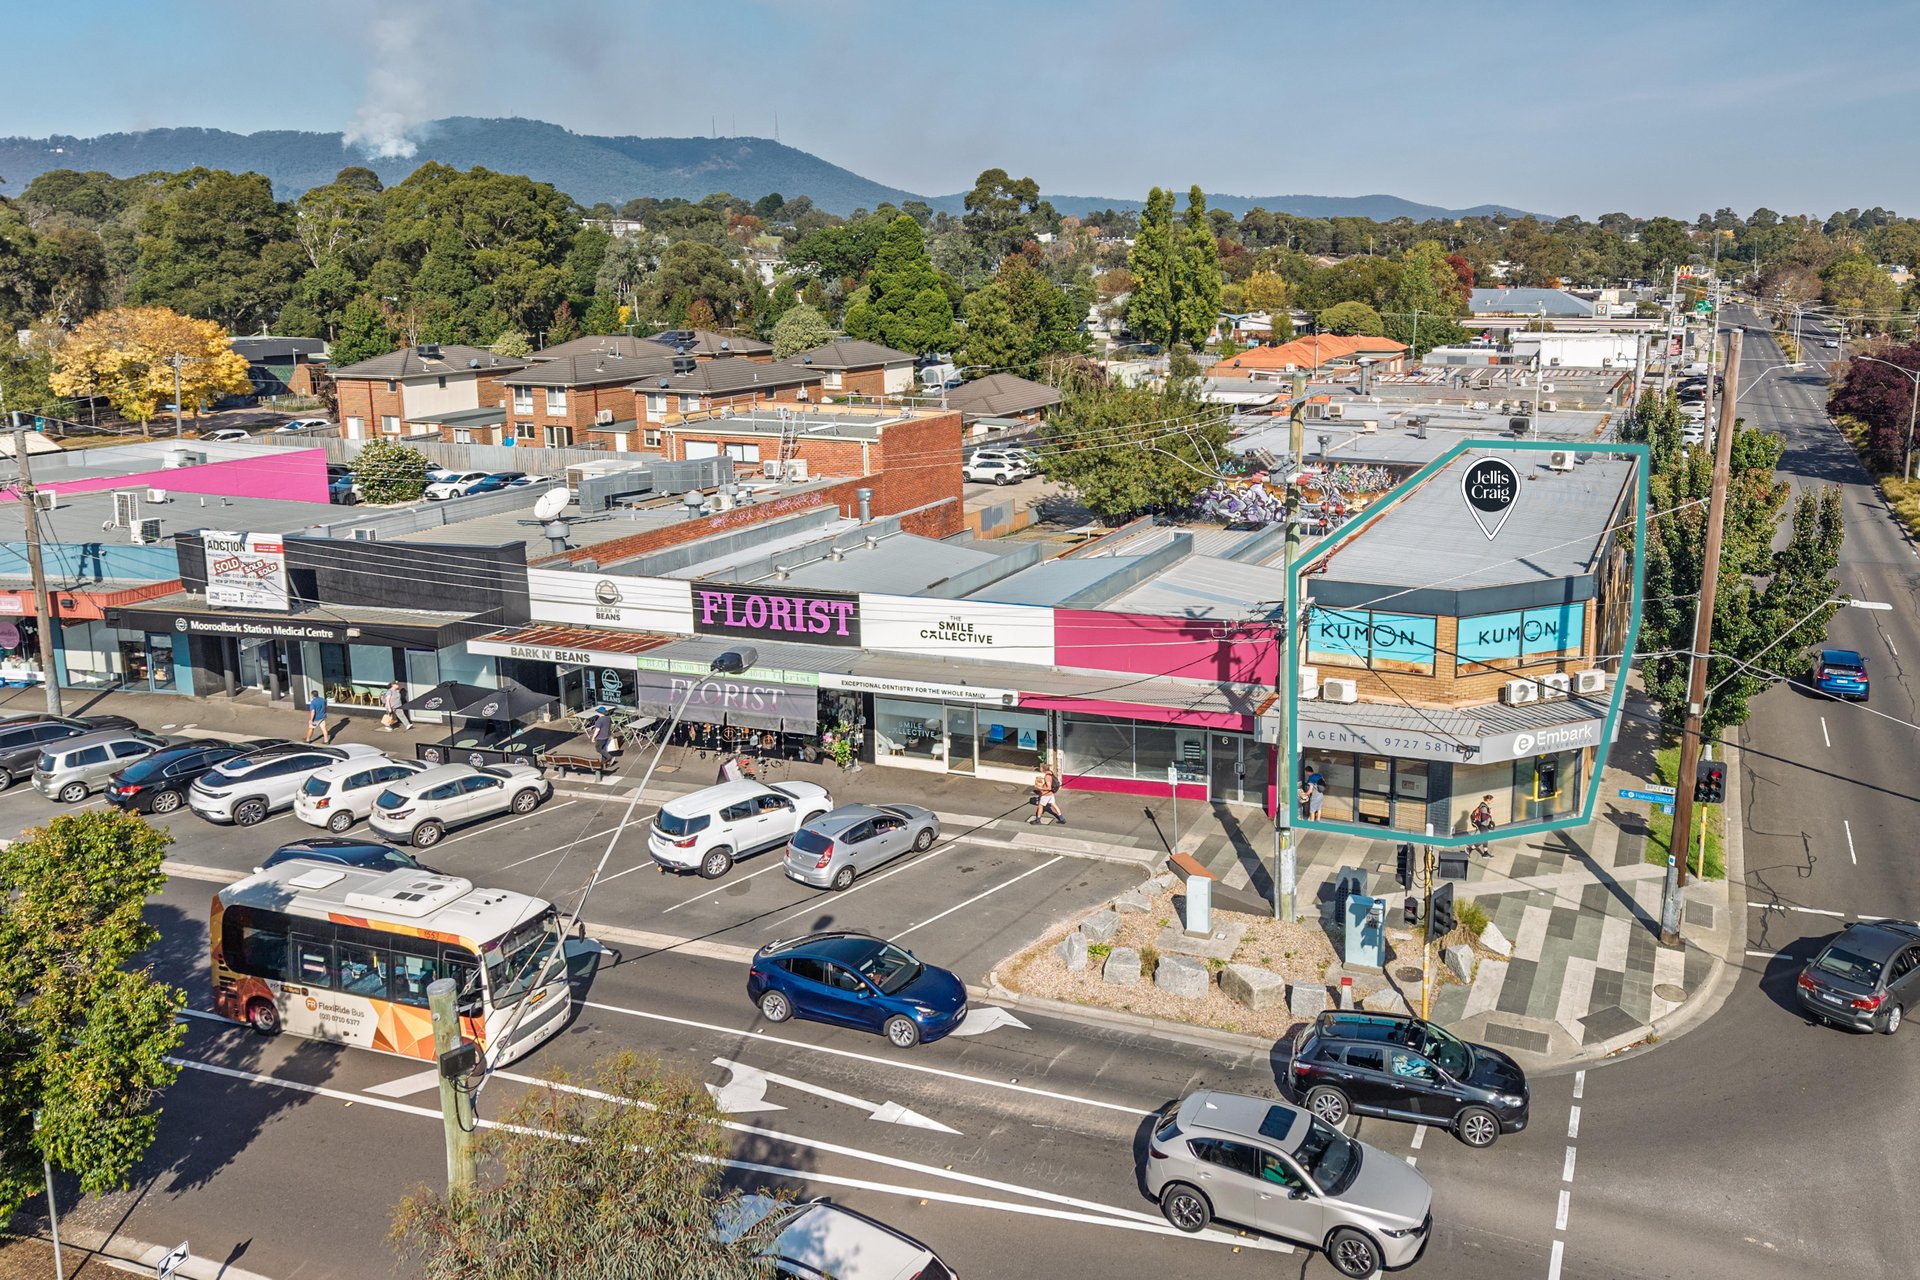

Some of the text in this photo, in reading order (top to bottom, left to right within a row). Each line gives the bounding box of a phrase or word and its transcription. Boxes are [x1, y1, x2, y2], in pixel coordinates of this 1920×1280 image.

[215, 559, 240, 574] SOLD
[244, 561, 264, 573] SOLD
[258, 564, 277, 576] SOLD
[596, 613, 621, 621] BEANS
[700, 591, 854, 637] FLORIST
[190, 621, 334, 639] Mooroolbark Station Medical Centre
[938, 621, 974, 633] SMILE
[1321, 622, 1414, 647] KUMON
[1478, 620, 1558, 646] KUMON
[510, 647, 539, 659] BARK
[555, 651, 590, 663] BEANS
[670, 678, 785, 713] FLORIST
[841, 680, 881, 690] EXCEPTIONAL
[882, 682, 914, 692] DENTISTRY
[941, 689, 964, 697] WHOLE
[965, 691, 987, 699] FAMILY
[887, 727, 936, 738] LLECTIVE
[898, 721, 923, 730] SMILE
[1222, 737, 1229, 745] 6
[1307, 729, 1367, 744] AGENTS
[1384, 737, 1419, 749] 9727
[1537, 724, 1593, 745] Embark
[318, 1002, 364, 1017] FlexiRide Bus
